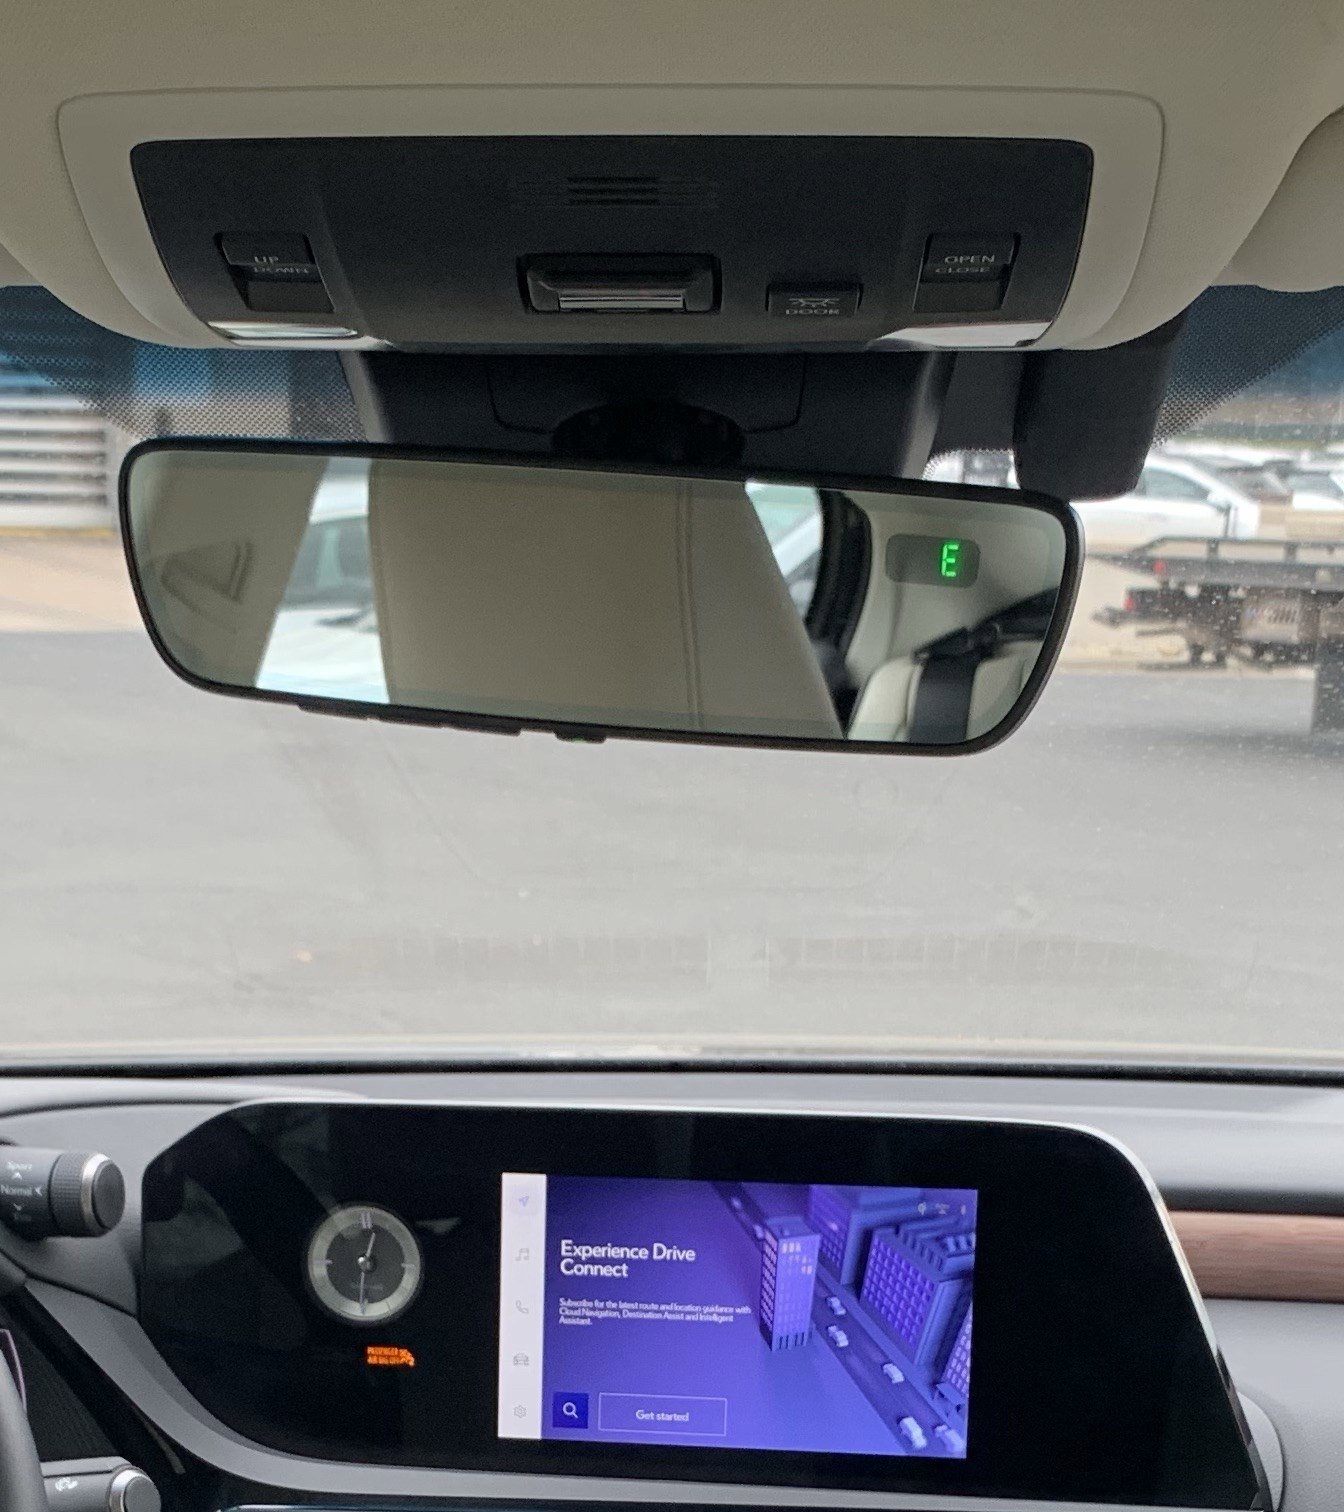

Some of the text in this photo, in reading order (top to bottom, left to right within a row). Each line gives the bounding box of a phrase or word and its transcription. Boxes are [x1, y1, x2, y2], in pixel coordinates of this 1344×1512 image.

[254, 256, 279, 264] UP
[944, 254, 996, 264] OPEN
[785, 308, 840, 316] DOOR
[941, 544, 960, 577] E
[0, 1184, 33, 1196] Normal
[560, 1239, 697, 1262] Experience Drive
[560, 1258, 629, 1278] Connect
[559, 1297, 752, 1315] Subscribe for the latest route and location guidance with
[559, 1307, 582, 1317] Cloud
[622, 1310, 663, 1320] Destination
[663, 1311, 685, 1321] Assist
[685, 1313, 699, 1322] and
[699, 1313, 734, 1325] Intelligent
[635, 1409, 690, 1422] Get started
